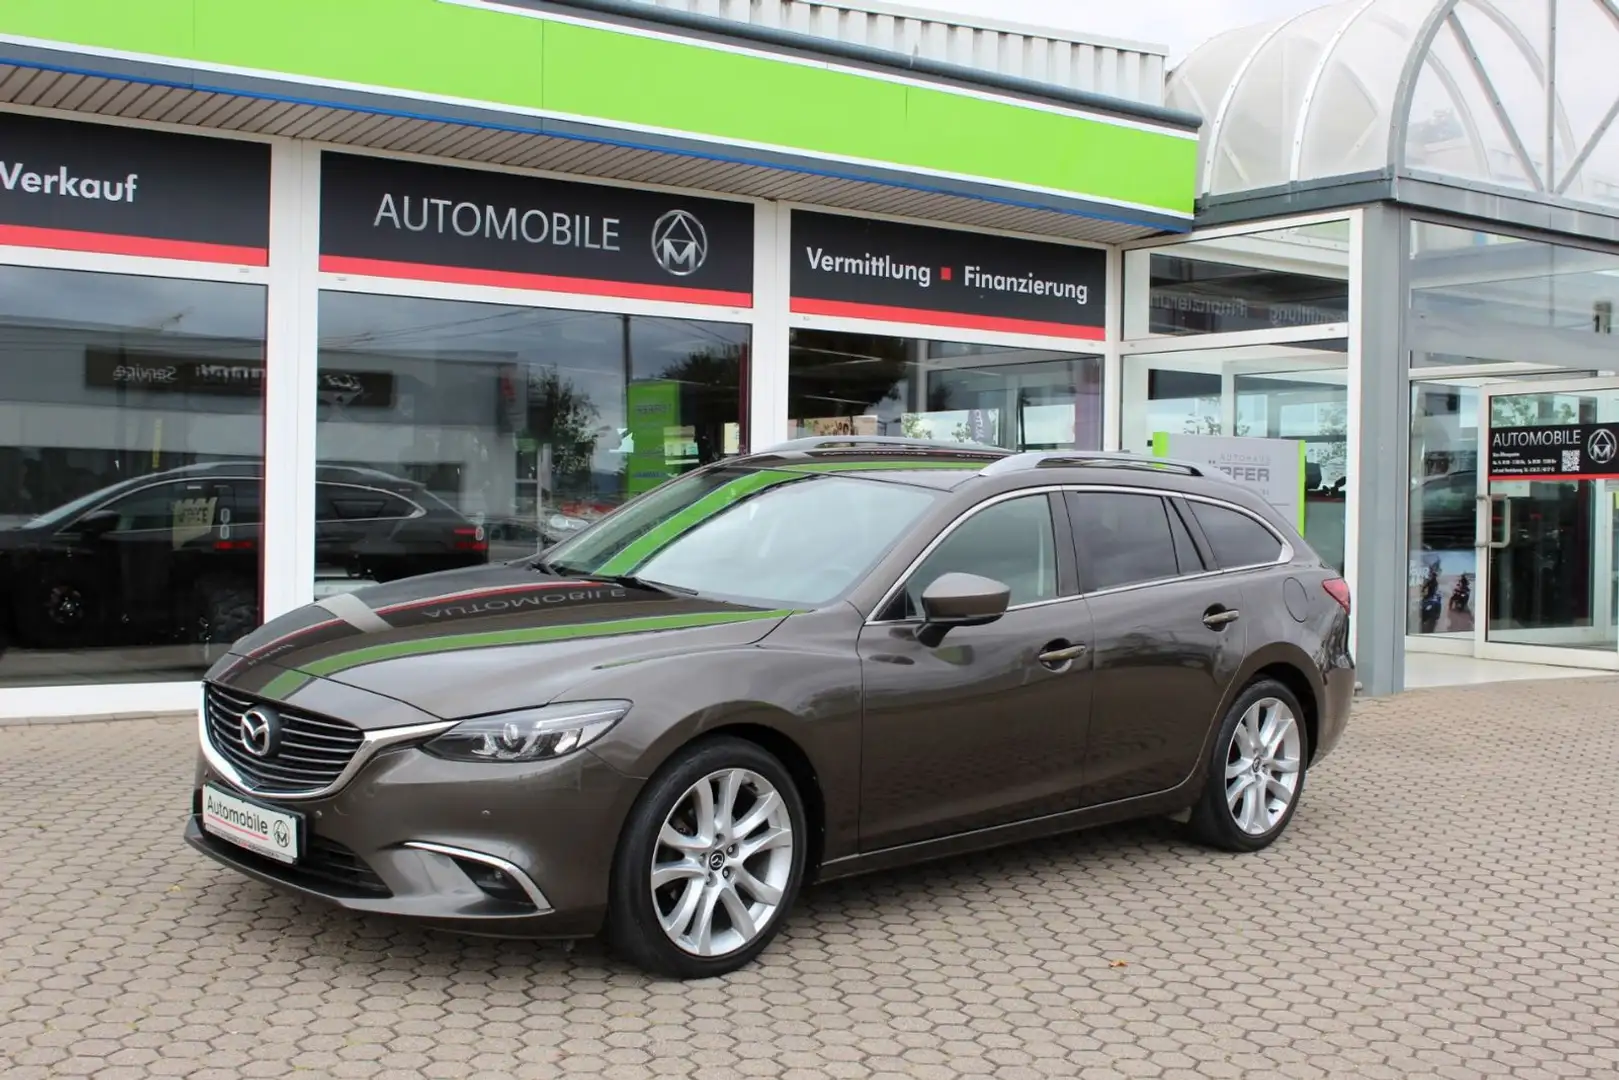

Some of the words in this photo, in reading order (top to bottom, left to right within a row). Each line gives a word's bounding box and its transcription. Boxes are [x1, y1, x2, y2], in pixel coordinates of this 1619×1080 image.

[0, 160, 139, 203] Verkauf
[373, 192, 621, 252] AUTOMOBILE
[806, 246, 932, 288] Vermittlung
[963, 264, 1088, 305] Finanzierung
[1493, 430, 1581, 447] AUTOMOBILE
[207, 795, 268, 835] Automobile
